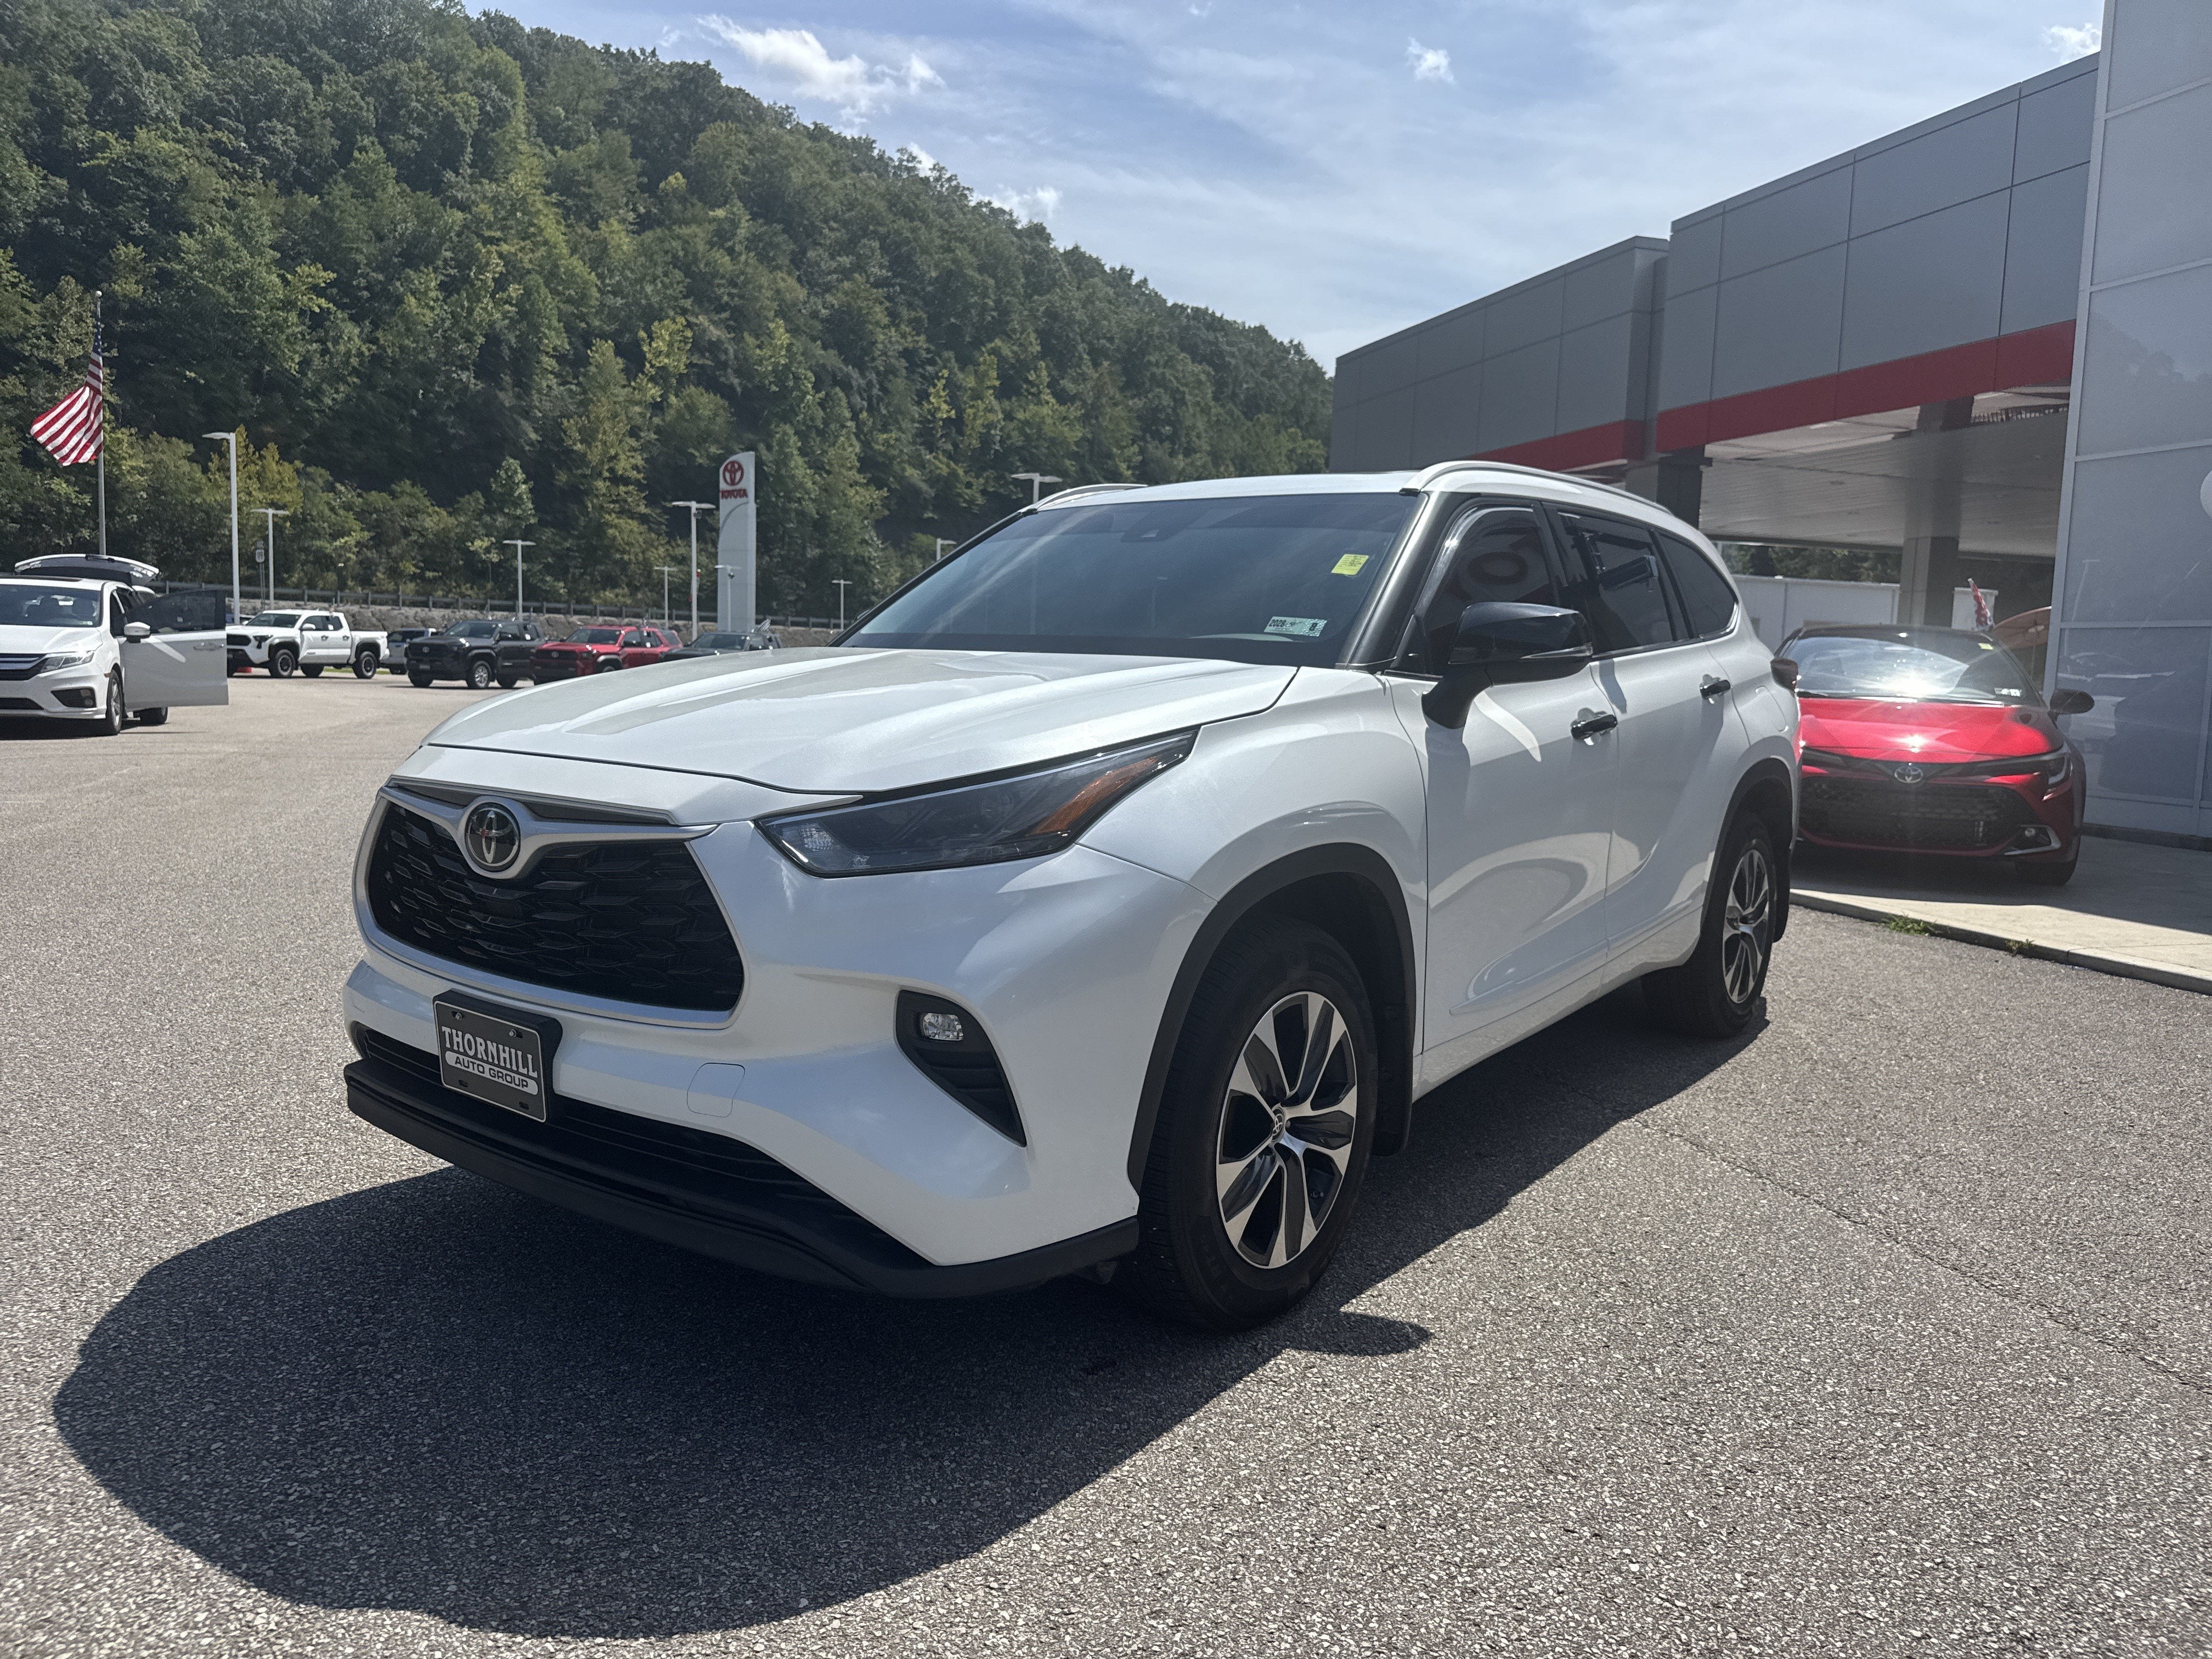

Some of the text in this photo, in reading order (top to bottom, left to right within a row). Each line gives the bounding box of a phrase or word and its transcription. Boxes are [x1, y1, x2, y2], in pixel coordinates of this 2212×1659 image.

[442, 1026, 538, 1078] THORNHILL
[455, 1056, 528, 1088] AUTO GROUP
